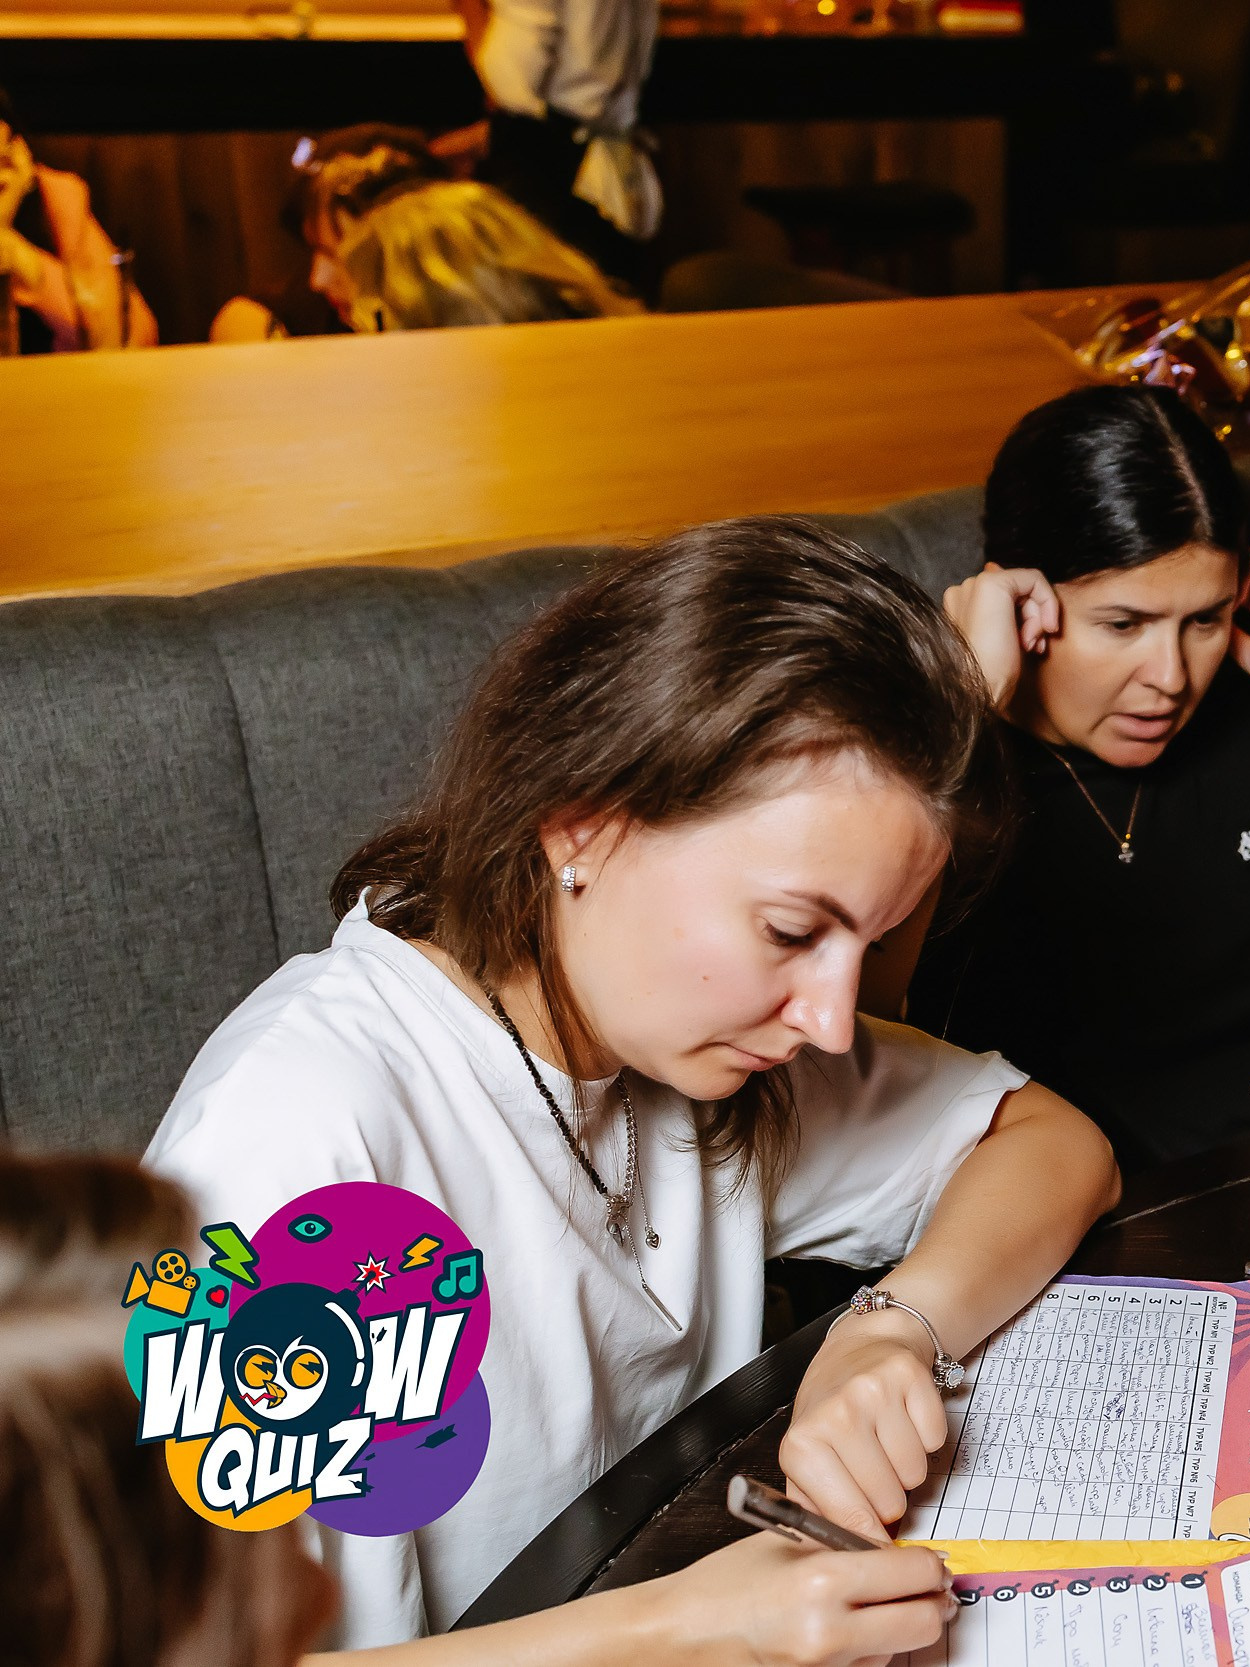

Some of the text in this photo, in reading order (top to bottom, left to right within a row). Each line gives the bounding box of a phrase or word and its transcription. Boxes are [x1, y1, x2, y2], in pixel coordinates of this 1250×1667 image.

[1170, 1299, 1182, 1309] 2
[1208, 1344, 1216, 1355] ТУР
[1204, 1371, 1212, 1383] ТУР
[1196, 1427, 1204, 1439] ТУР
[1192, 1458, 1200, 1471] ТУР
[1188, 1491, 1197, 1505] ТУР
[1109, 1580, 1127, 1590] 3
[1147, 1578, 1164, 1588] 2
[1185, 1578, 1202, 1586] 1
[1232, 1571, 1244, 1604] КОМАНДА
[1034, 1586, 1051, 1596] 5
[1071, 1583, 1089, 1594] 4
[996, 1590, 1014, 1600] 6
